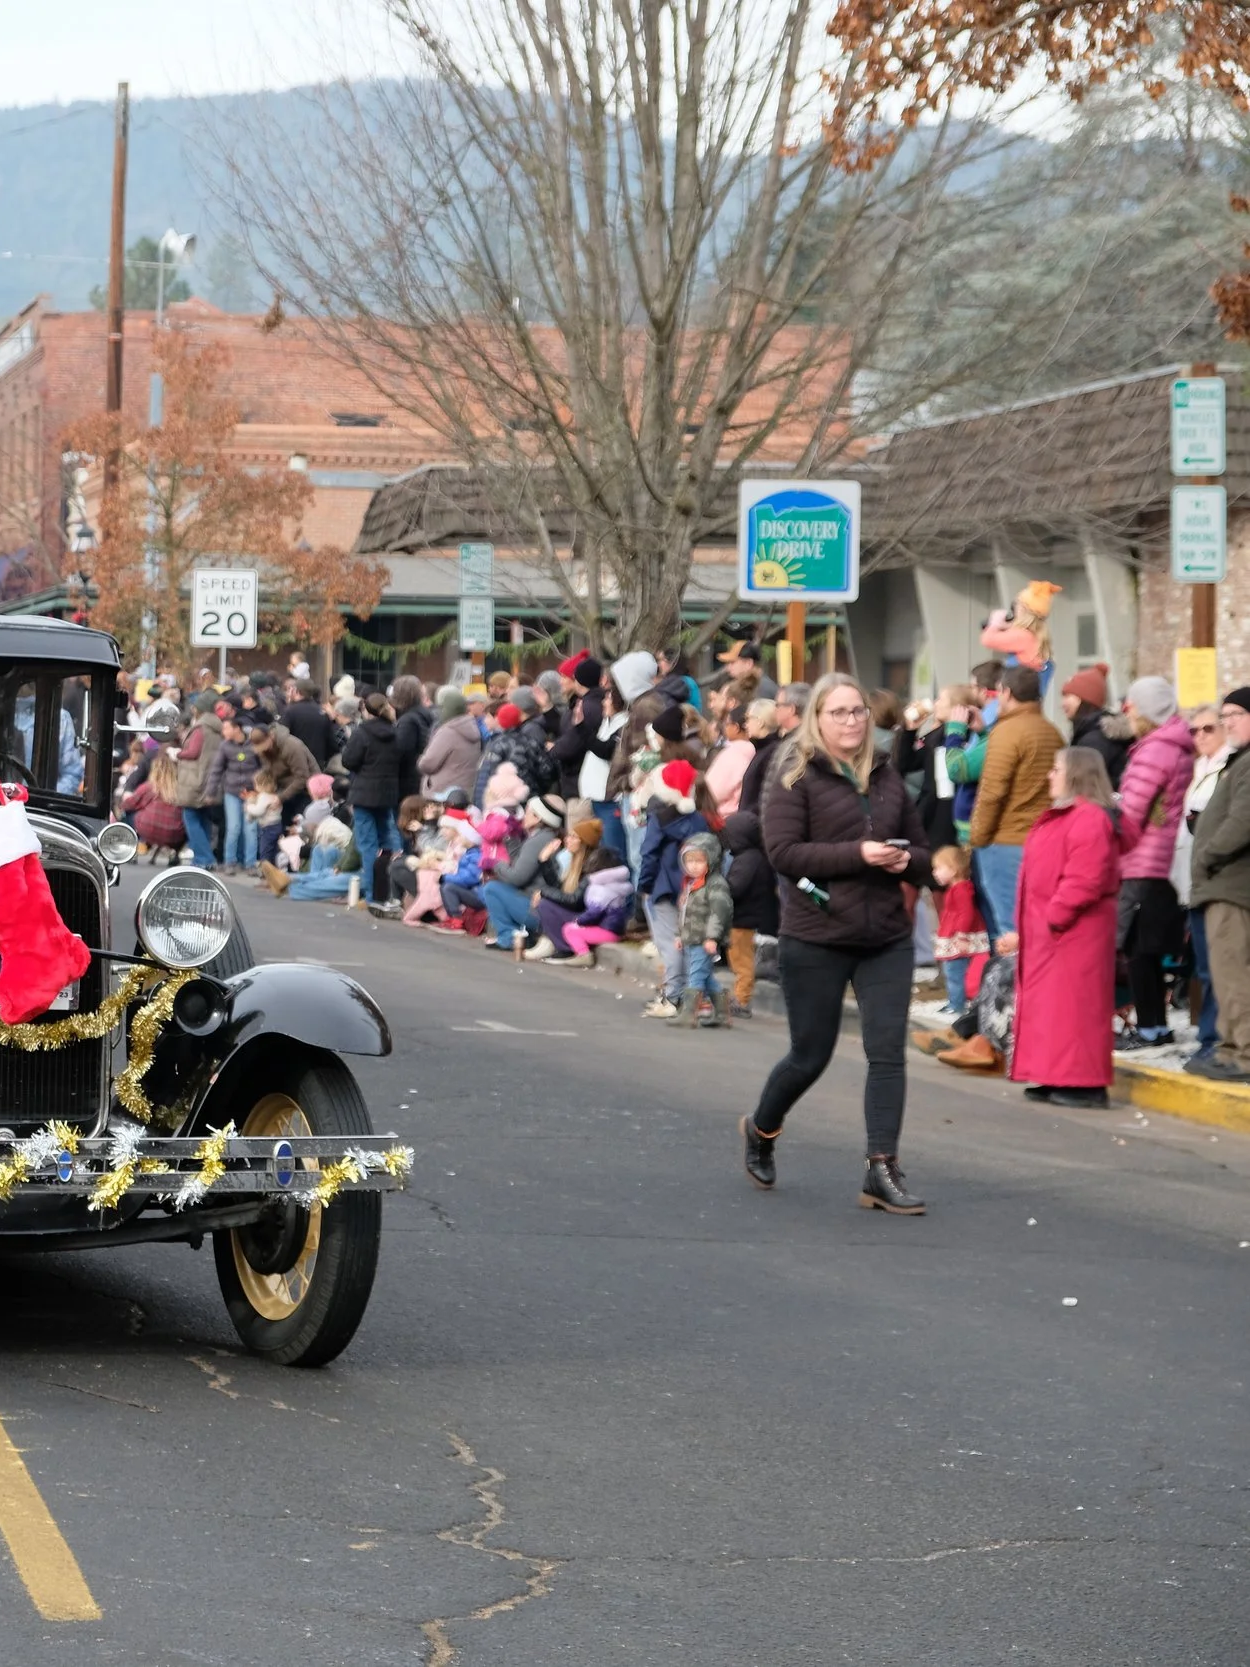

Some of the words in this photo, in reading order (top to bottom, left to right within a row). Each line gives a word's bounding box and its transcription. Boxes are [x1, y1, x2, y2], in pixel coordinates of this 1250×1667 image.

[759, 520, 842, 540] DISCOVERY
[776, 540, 826, 560] DRIVE
[201, 578, 251, 591] SPEED
[205, 595, 243, 606] LIMIT
[201, 611, 247, 637] 20
